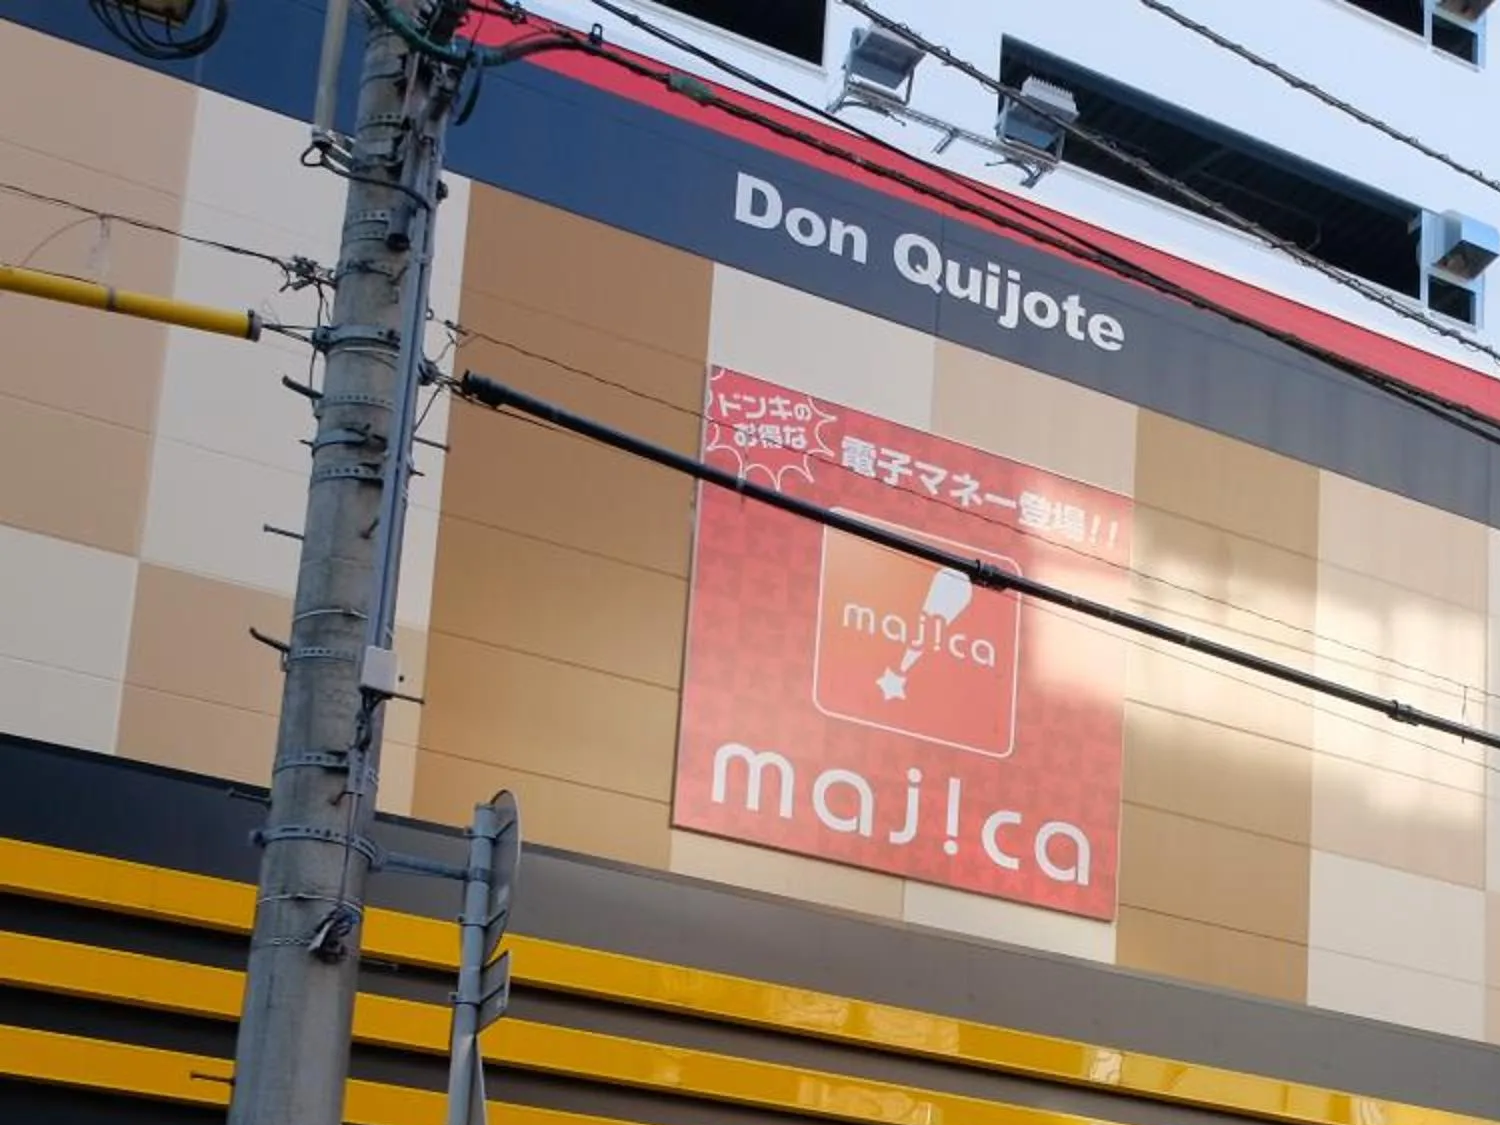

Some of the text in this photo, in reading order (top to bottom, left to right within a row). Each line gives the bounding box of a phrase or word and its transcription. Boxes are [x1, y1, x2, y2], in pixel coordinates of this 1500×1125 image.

[734, 170, 1126, 353] Don Quijote
[719, 390, 813, 424] ドンキの
[734, 422, 808, 451] お得な
